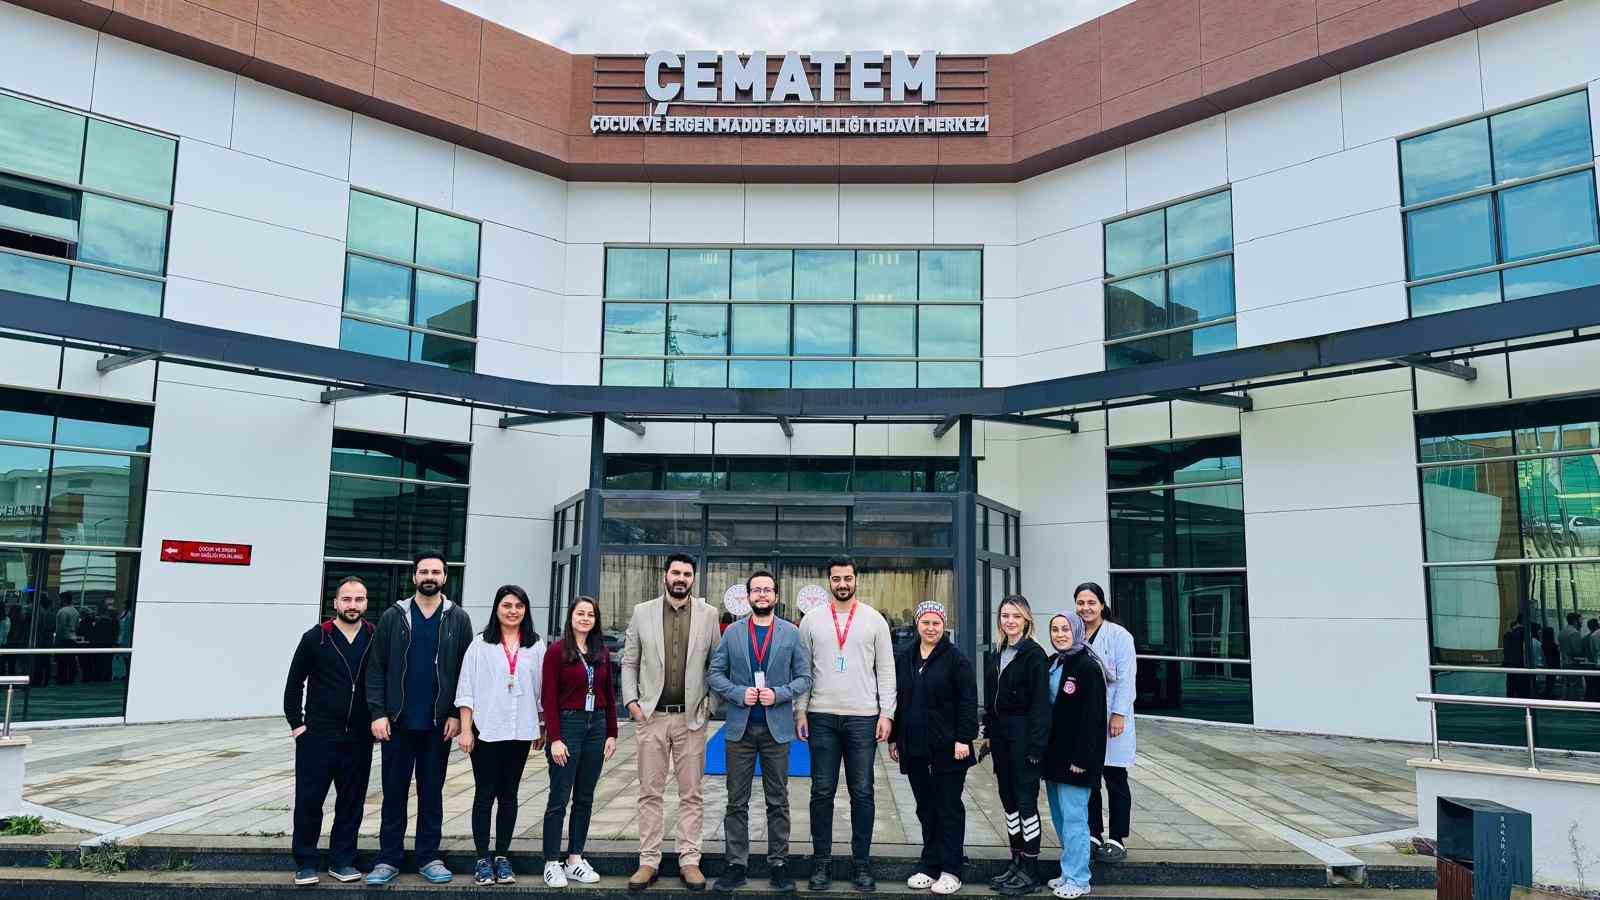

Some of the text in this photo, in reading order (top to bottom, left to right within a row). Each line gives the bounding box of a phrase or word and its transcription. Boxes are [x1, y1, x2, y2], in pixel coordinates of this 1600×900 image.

[644, 50, 936, 116] ÇEMATEM
[590, 114, 989, 133] ÇOCUK VE ERGEN MADDE BAĞIMLILIĞI TEDAVİ MERKEZİ
